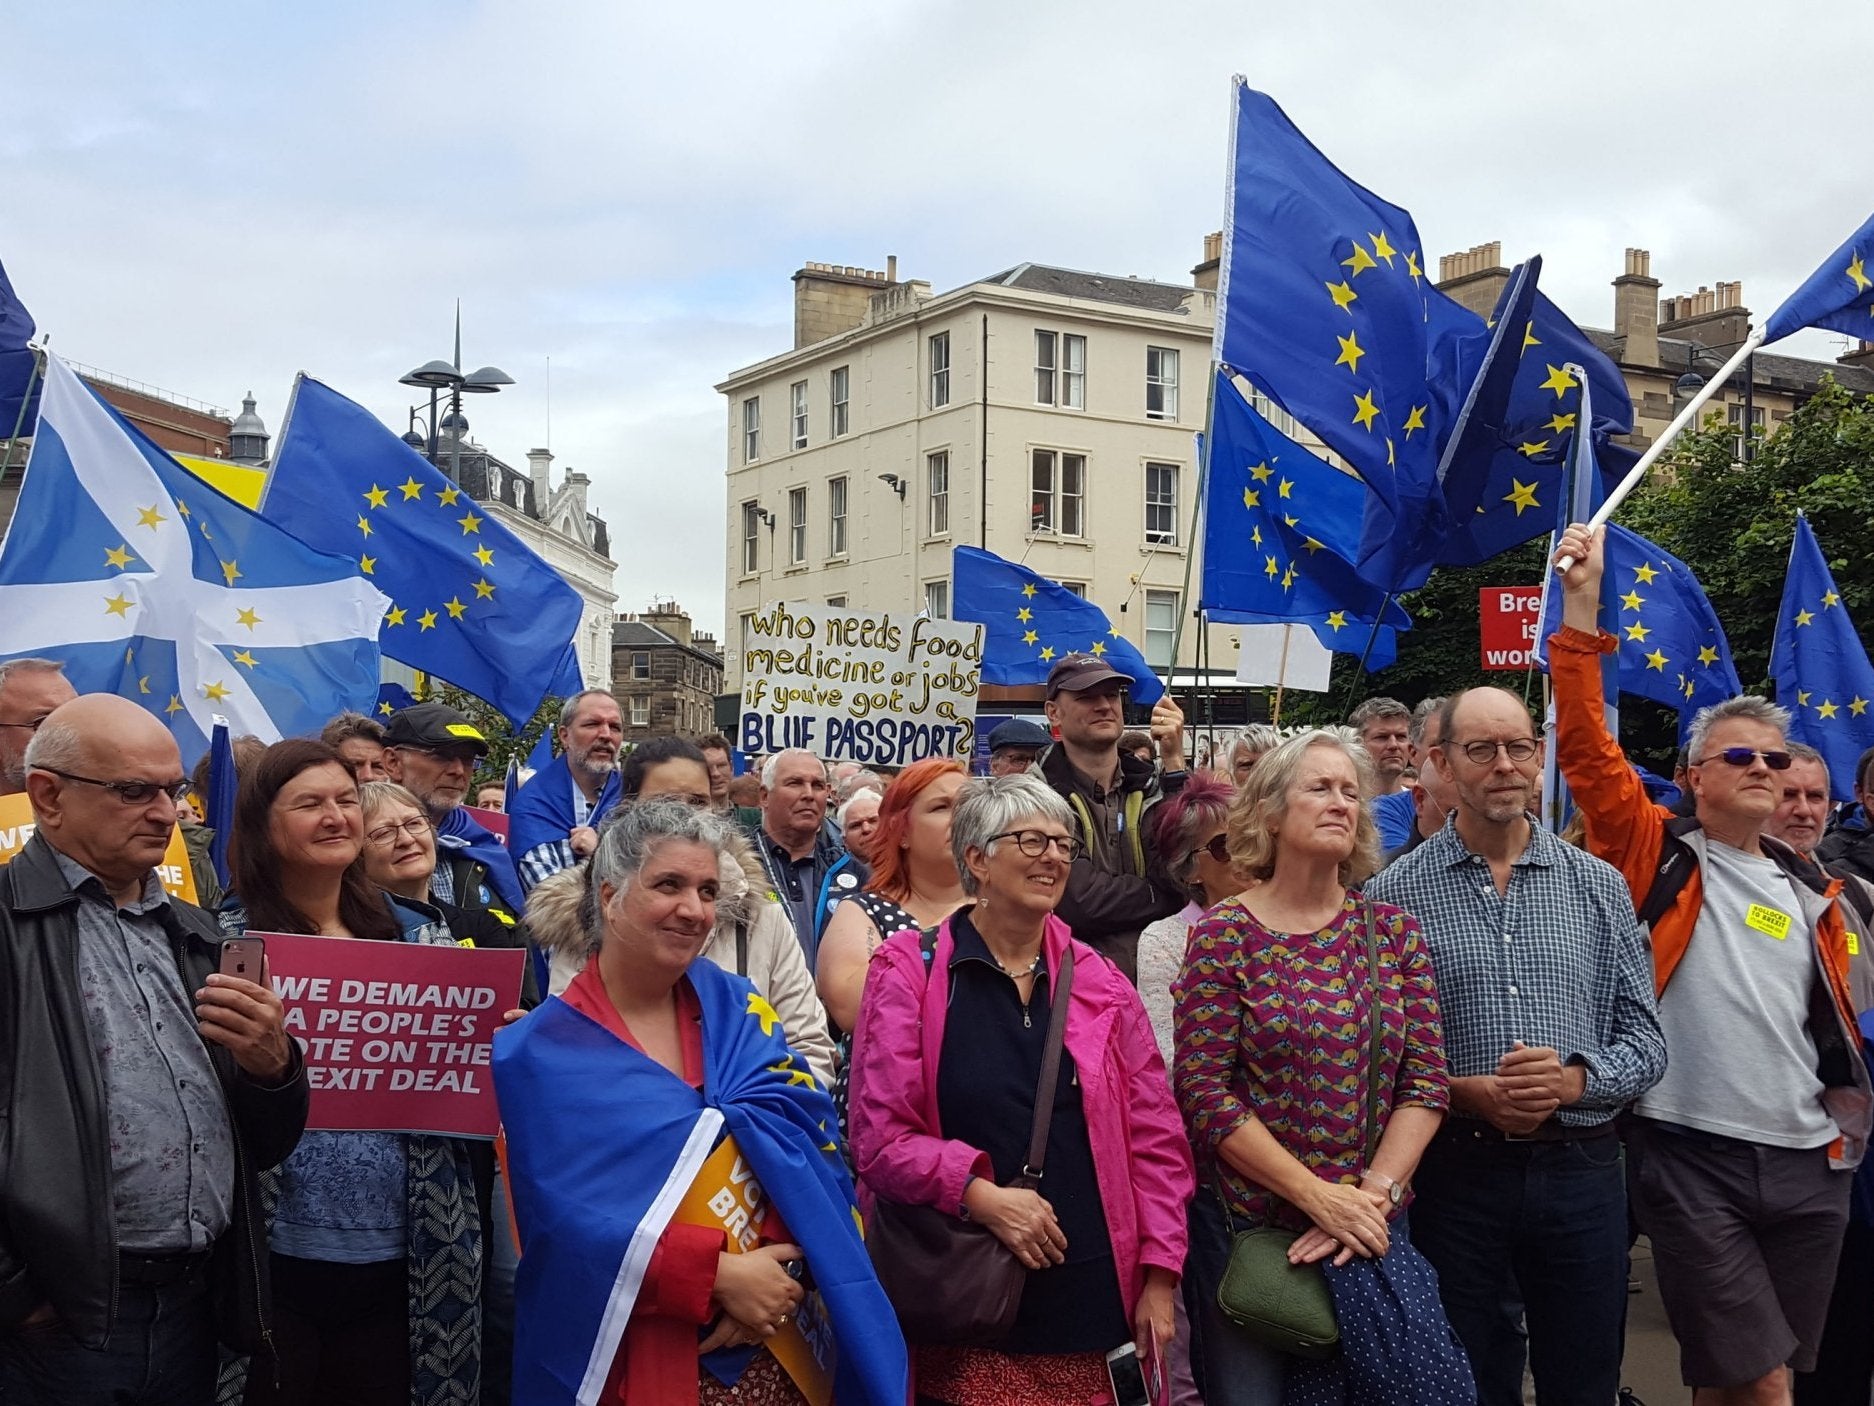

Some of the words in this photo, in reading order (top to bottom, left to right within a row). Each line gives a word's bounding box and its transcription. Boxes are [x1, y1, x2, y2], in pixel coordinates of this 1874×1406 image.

[1500, 593, 1541, 612] Bre
[751, 602, 815, 639] who
[827, 614, 902, 652] needs
[1486, 650, 1533, 665] wor
[746, 644, 884, 684] medicine
[891, 670, 918, 688] or
[910, 660, 979, 714] jobs
[745, 679, 768, 709] if
[771, 683, 842, 714] you've
[848, 688, 903, 718] got
[935, 701, 957, 720] a
[153, 864, 184, 886] HE
[271, 976, 332, 1002] WE
[338, 980, 496, 1010] DEMAND
[283, 1008, 307, 1031] A
[316, 1009, 477, 1037] PEOPLE'S
[298, 1037, 354, 1062] TE
[361, 1040, 418, 1063] ON
[426, 1042, 494, 1066] THE
[307, 1066, 384, 1091] EXIT
[389, 1070, 481, 1094] DEAL
[707, 1186, 758, 1254] BRE
